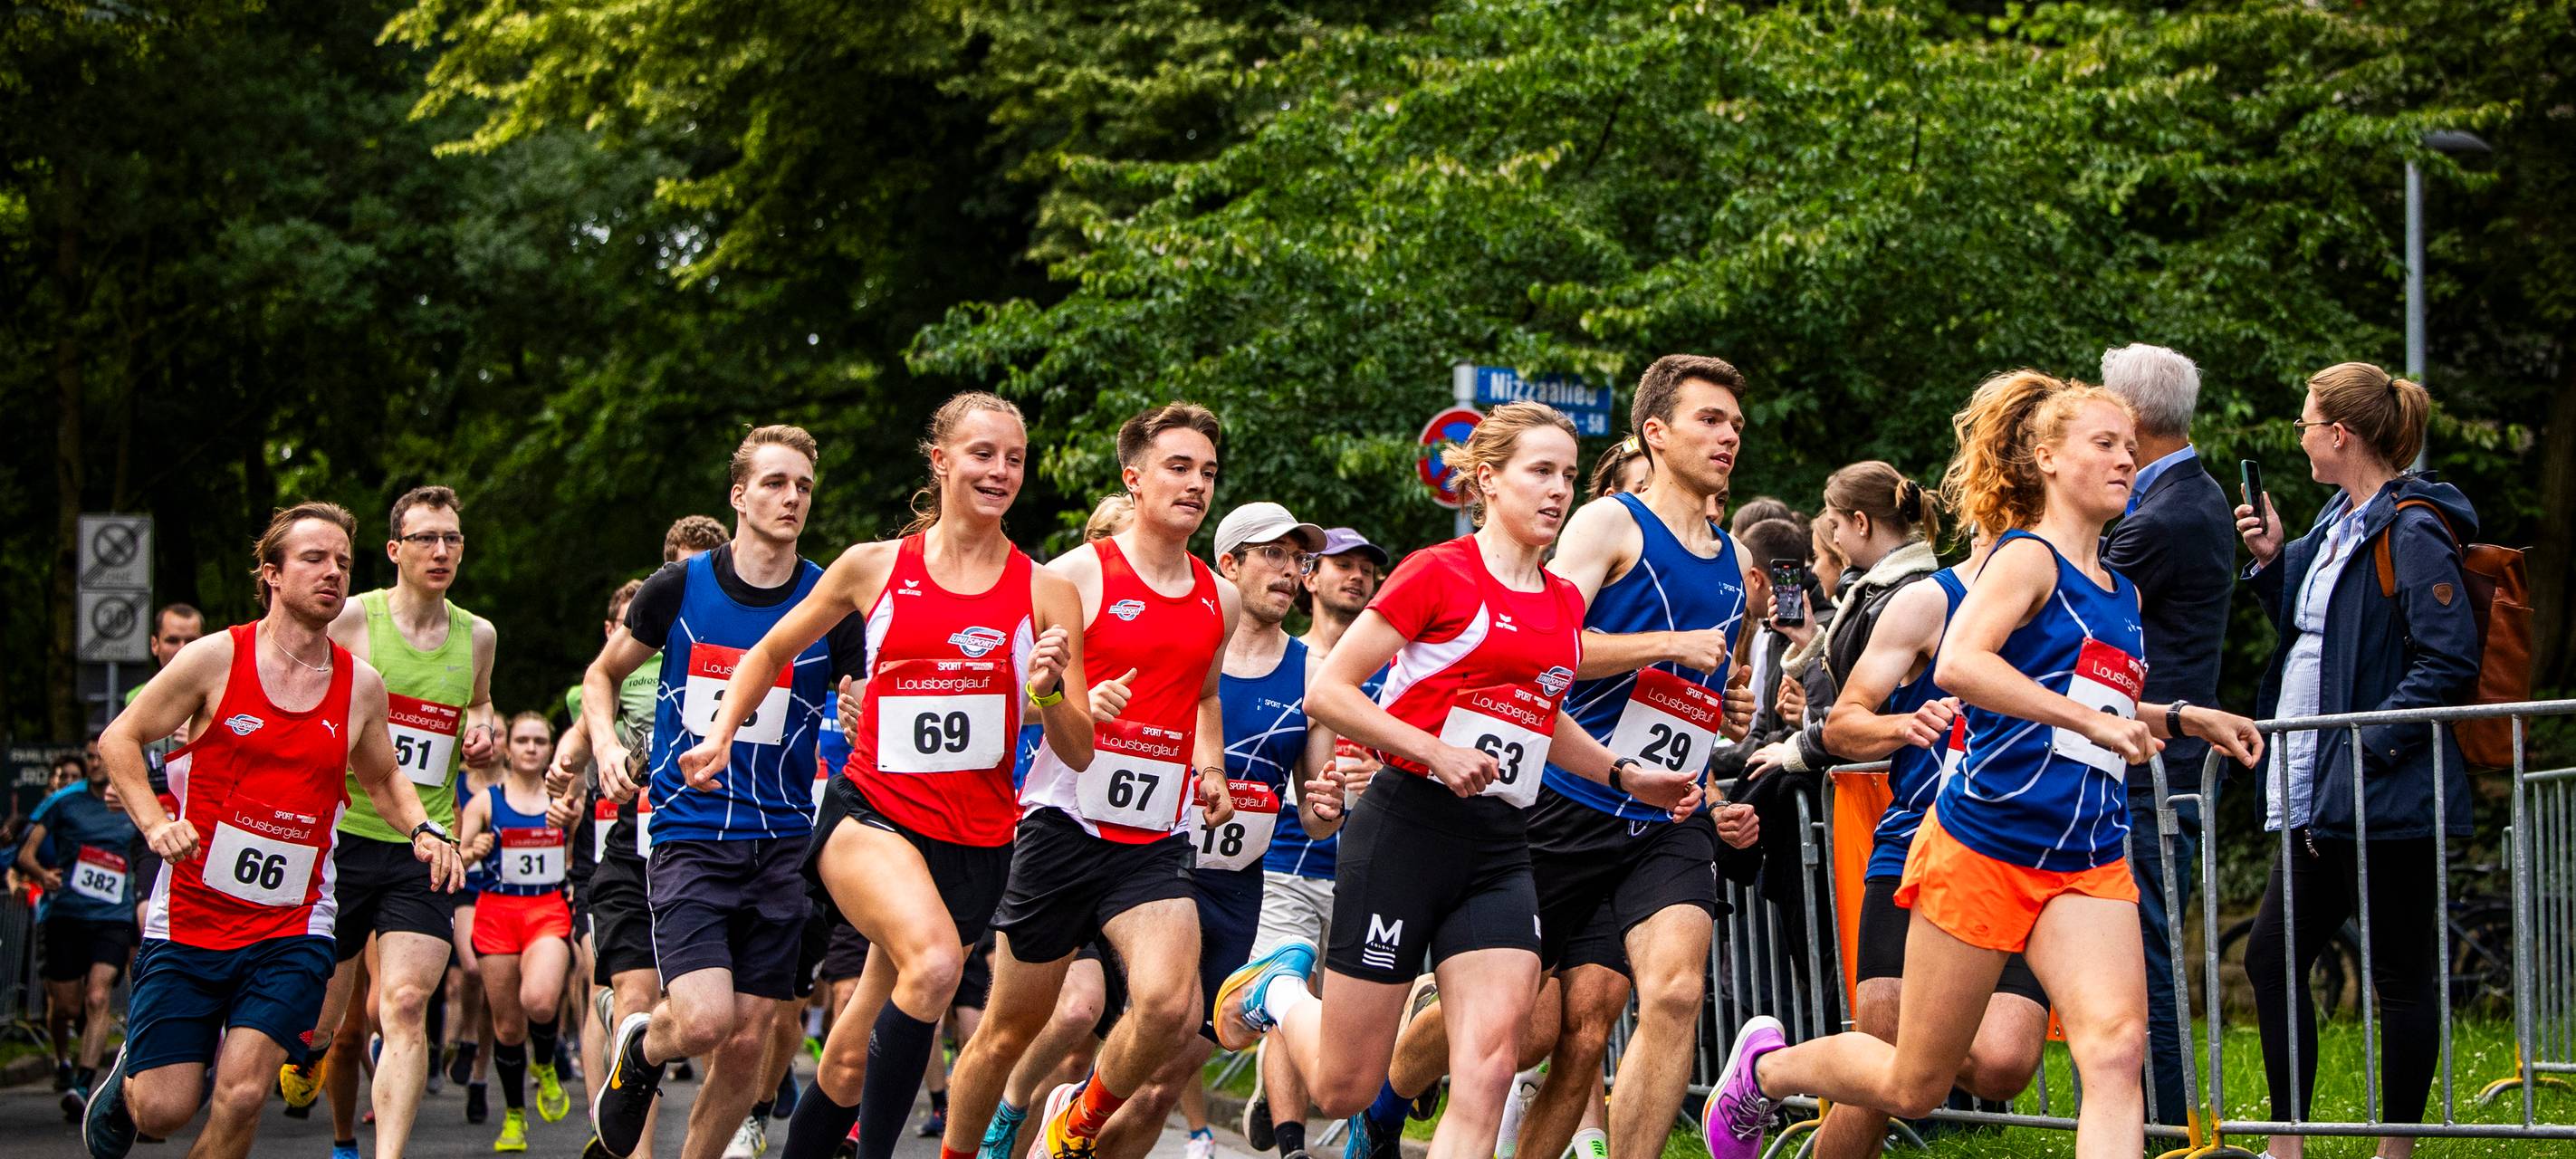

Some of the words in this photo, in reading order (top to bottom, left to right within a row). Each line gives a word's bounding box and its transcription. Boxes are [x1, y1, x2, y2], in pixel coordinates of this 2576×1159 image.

[967, 637, 995, 649] SPORT
[938, 663, 963, 671] SPORT
[896, 676, 991, 693] Lousberglauf
[1515, 688, 1533, 703] SPORT
[1686, 687, 1704, 700] SPORT
[421, 704, 439, 714] SPORT
[1471, 693, 1546, 727] Lousberglauf
[1648, 687, 1716, 723] Lousberglauf
[388, 709, 453, 731] Lousberglauf
[914, 711, 971, 754] 69
[1143, 726, 1163, 737] SPORT
[395, 734, 432, 771] 51
[1102, 733, 1180, 757] Lousberglauf
[1639, 723, 1692, 771] 29
[1475, 733, 1524, 785] 63
[1107, 769, 1160, 812] 67
[1229, 781, 1249, 790] SPORT
[235, 810, 311, 839] Lousberglauf
[274, 810, 295, 821] SPORT
[1200, 822, 1246, 857] 18
[234, 847, 288, 890] 66
[519, 853, 546, 876] 31
[81, 868, 117, 895] 382
[1365, 913, 1403, 947] M
